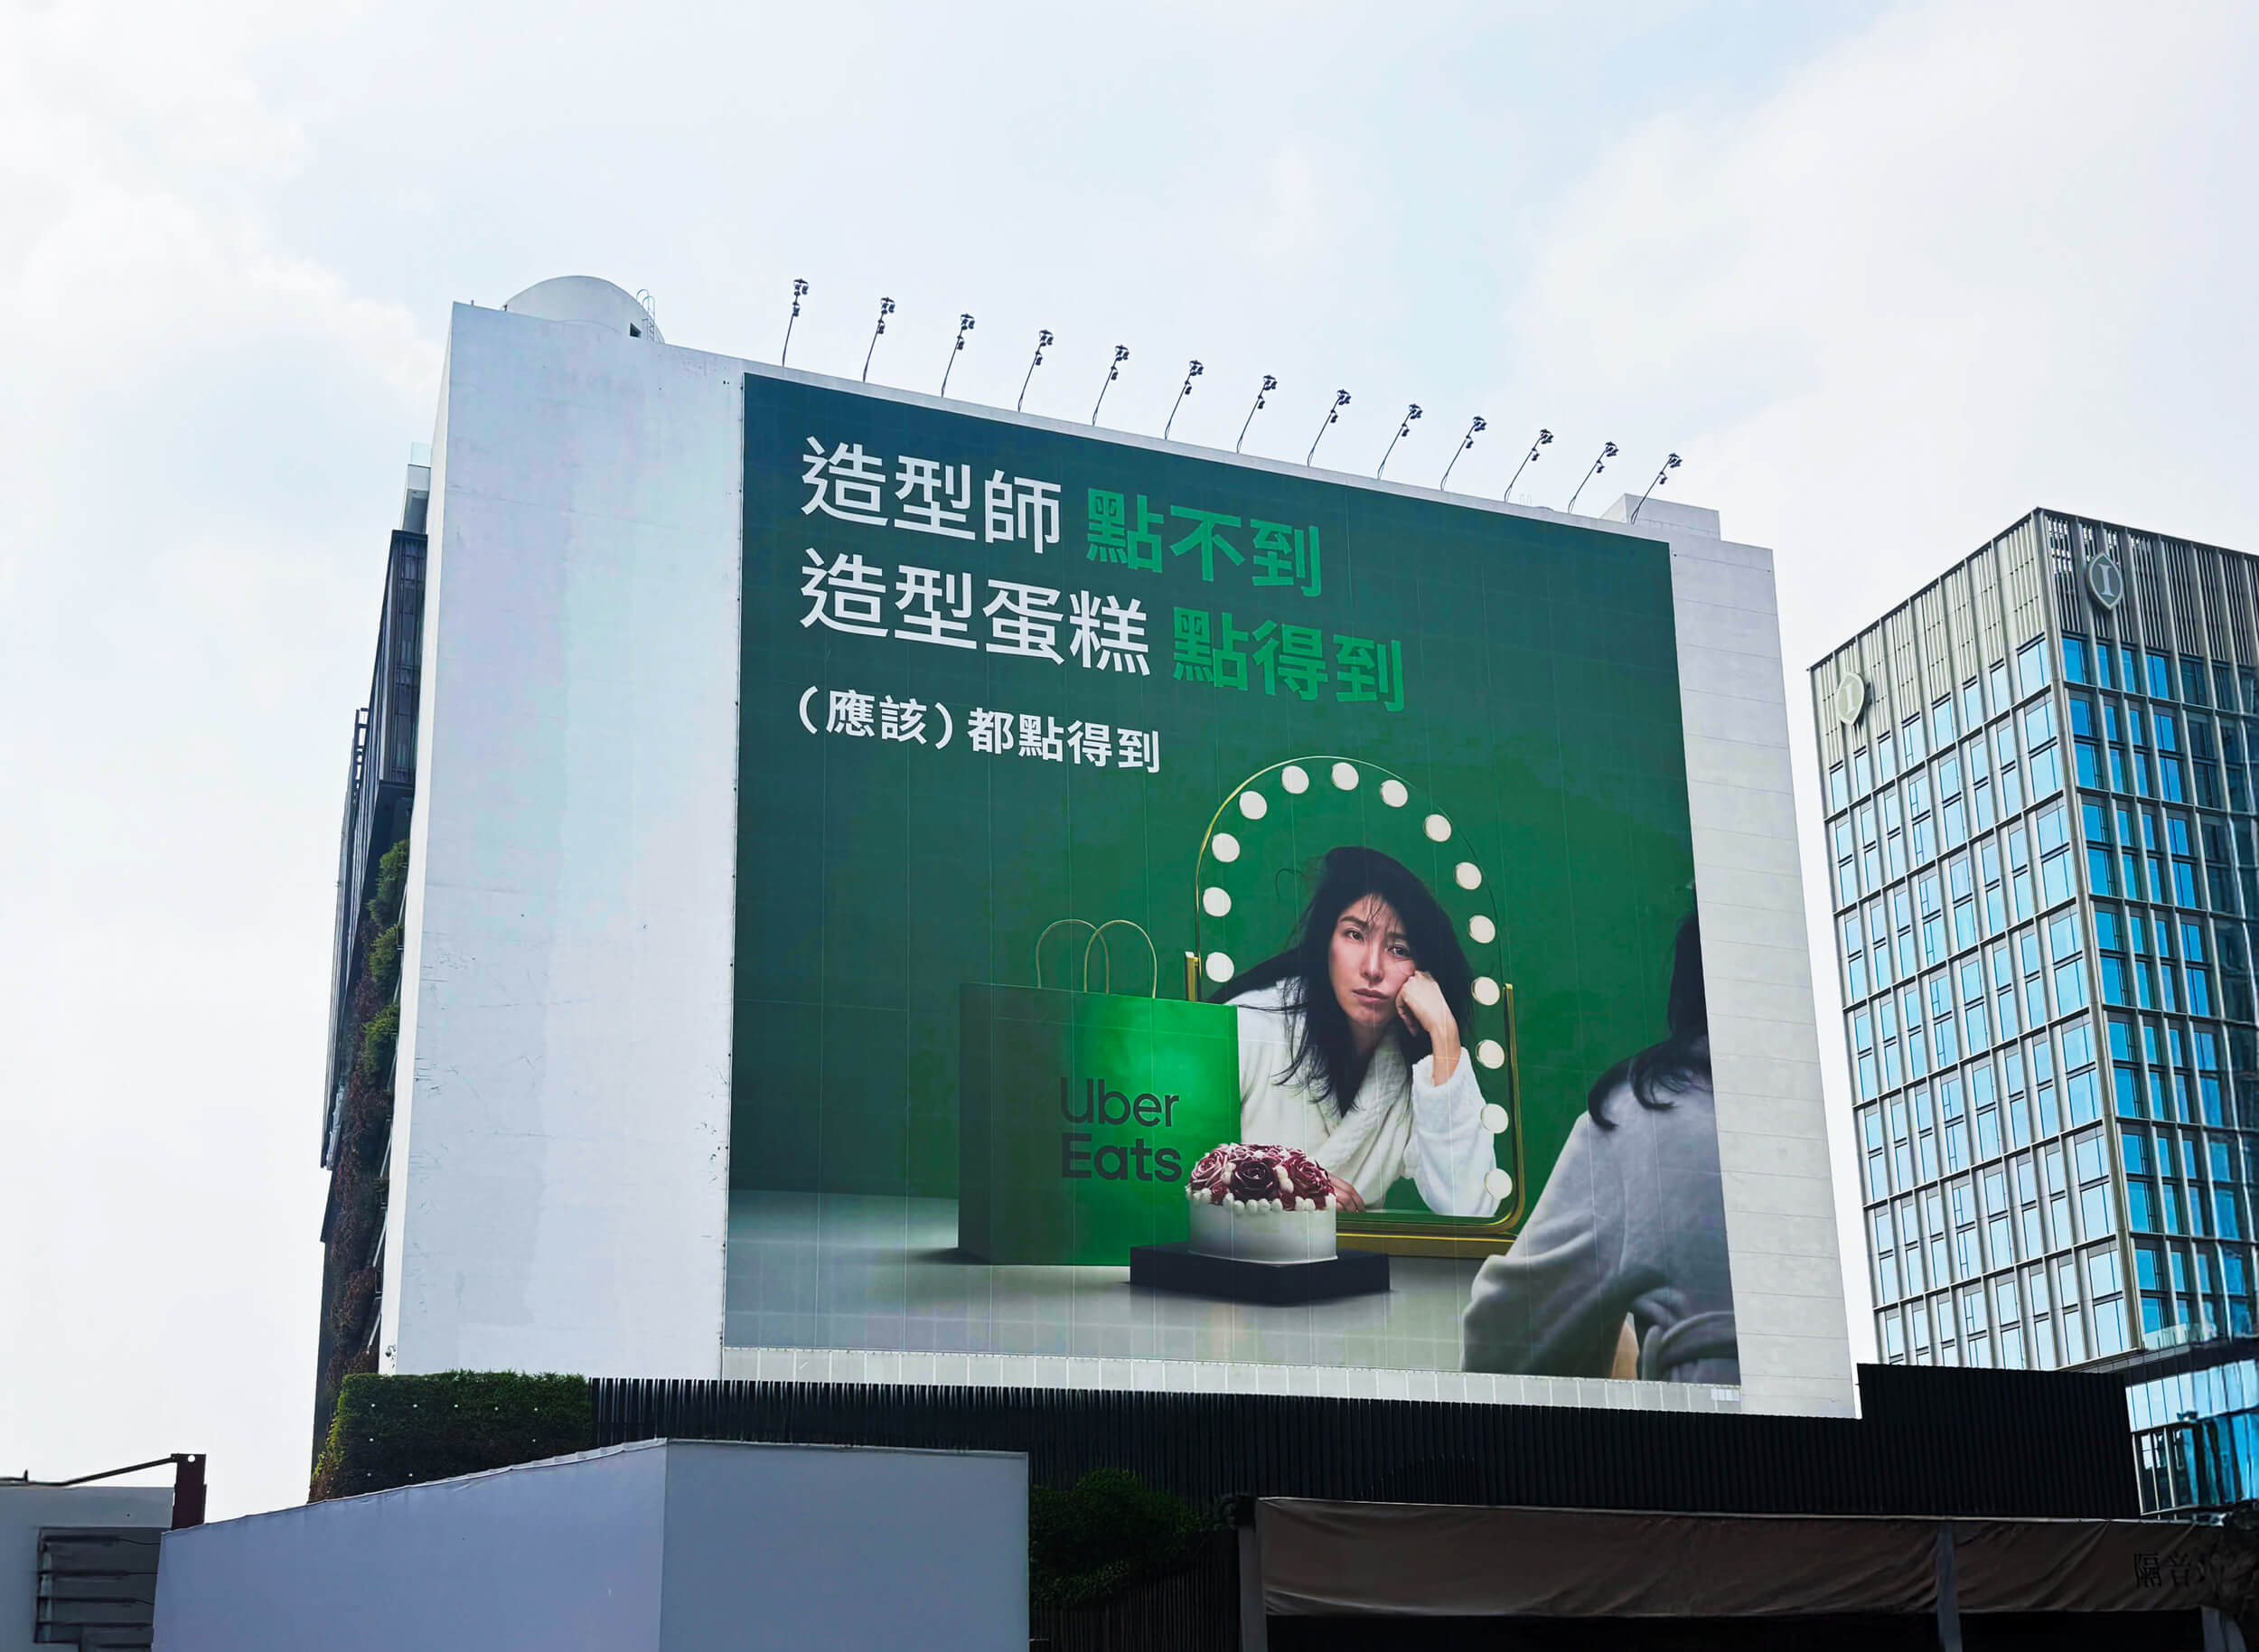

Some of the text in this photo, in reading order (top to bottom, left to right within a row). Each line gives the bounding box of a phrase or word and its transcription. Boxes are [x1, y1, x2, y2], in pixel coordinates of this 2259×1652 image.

[801, 436, 1322, 597] 造型師 點不到
[800, 548, 1404, 712] 造型蛋糕 點得到
[1060, 1077, 1179, 1127] Uber
[1062, 1132, 1182, 1182] Eats
